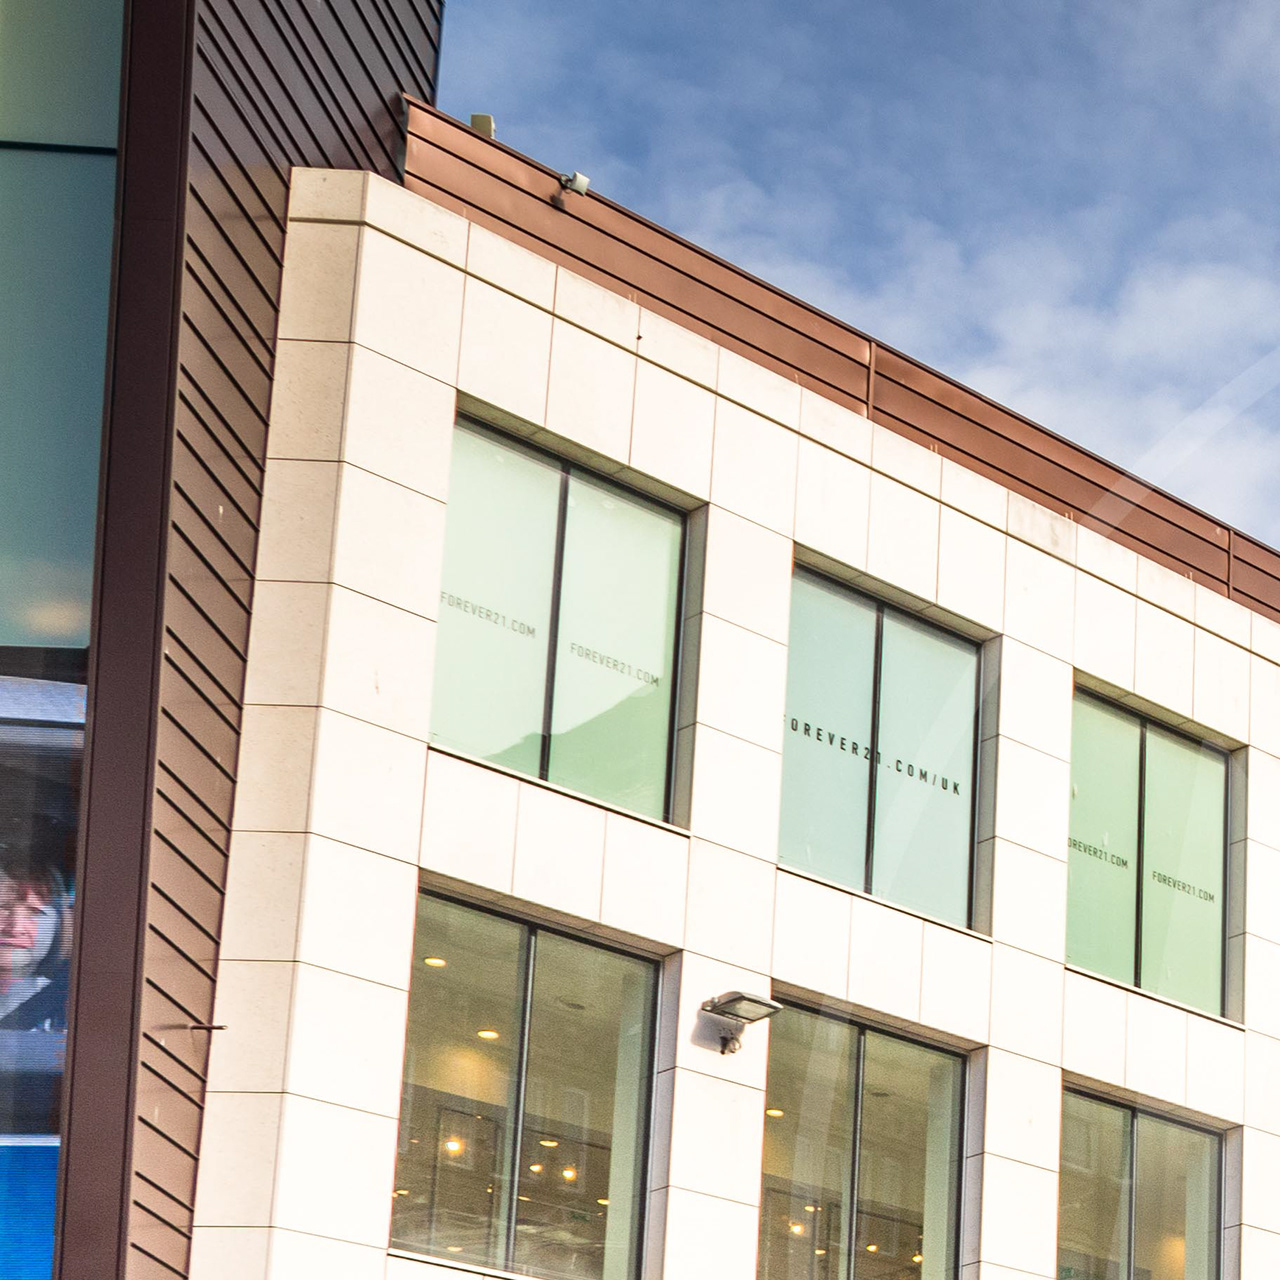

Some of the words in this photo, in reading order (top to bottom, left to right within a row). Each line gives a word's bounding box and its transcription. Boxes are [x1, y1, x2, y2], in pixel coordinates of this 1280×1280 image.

[440, 591, 537, 638] FOREVER21.COM
[570, 642, 659, 687] FOREVER21.COM
[784, 714, 960, 795] OREVER21.COM/UK
[1152, 871, 1215, 903] FOREVER21.COM
